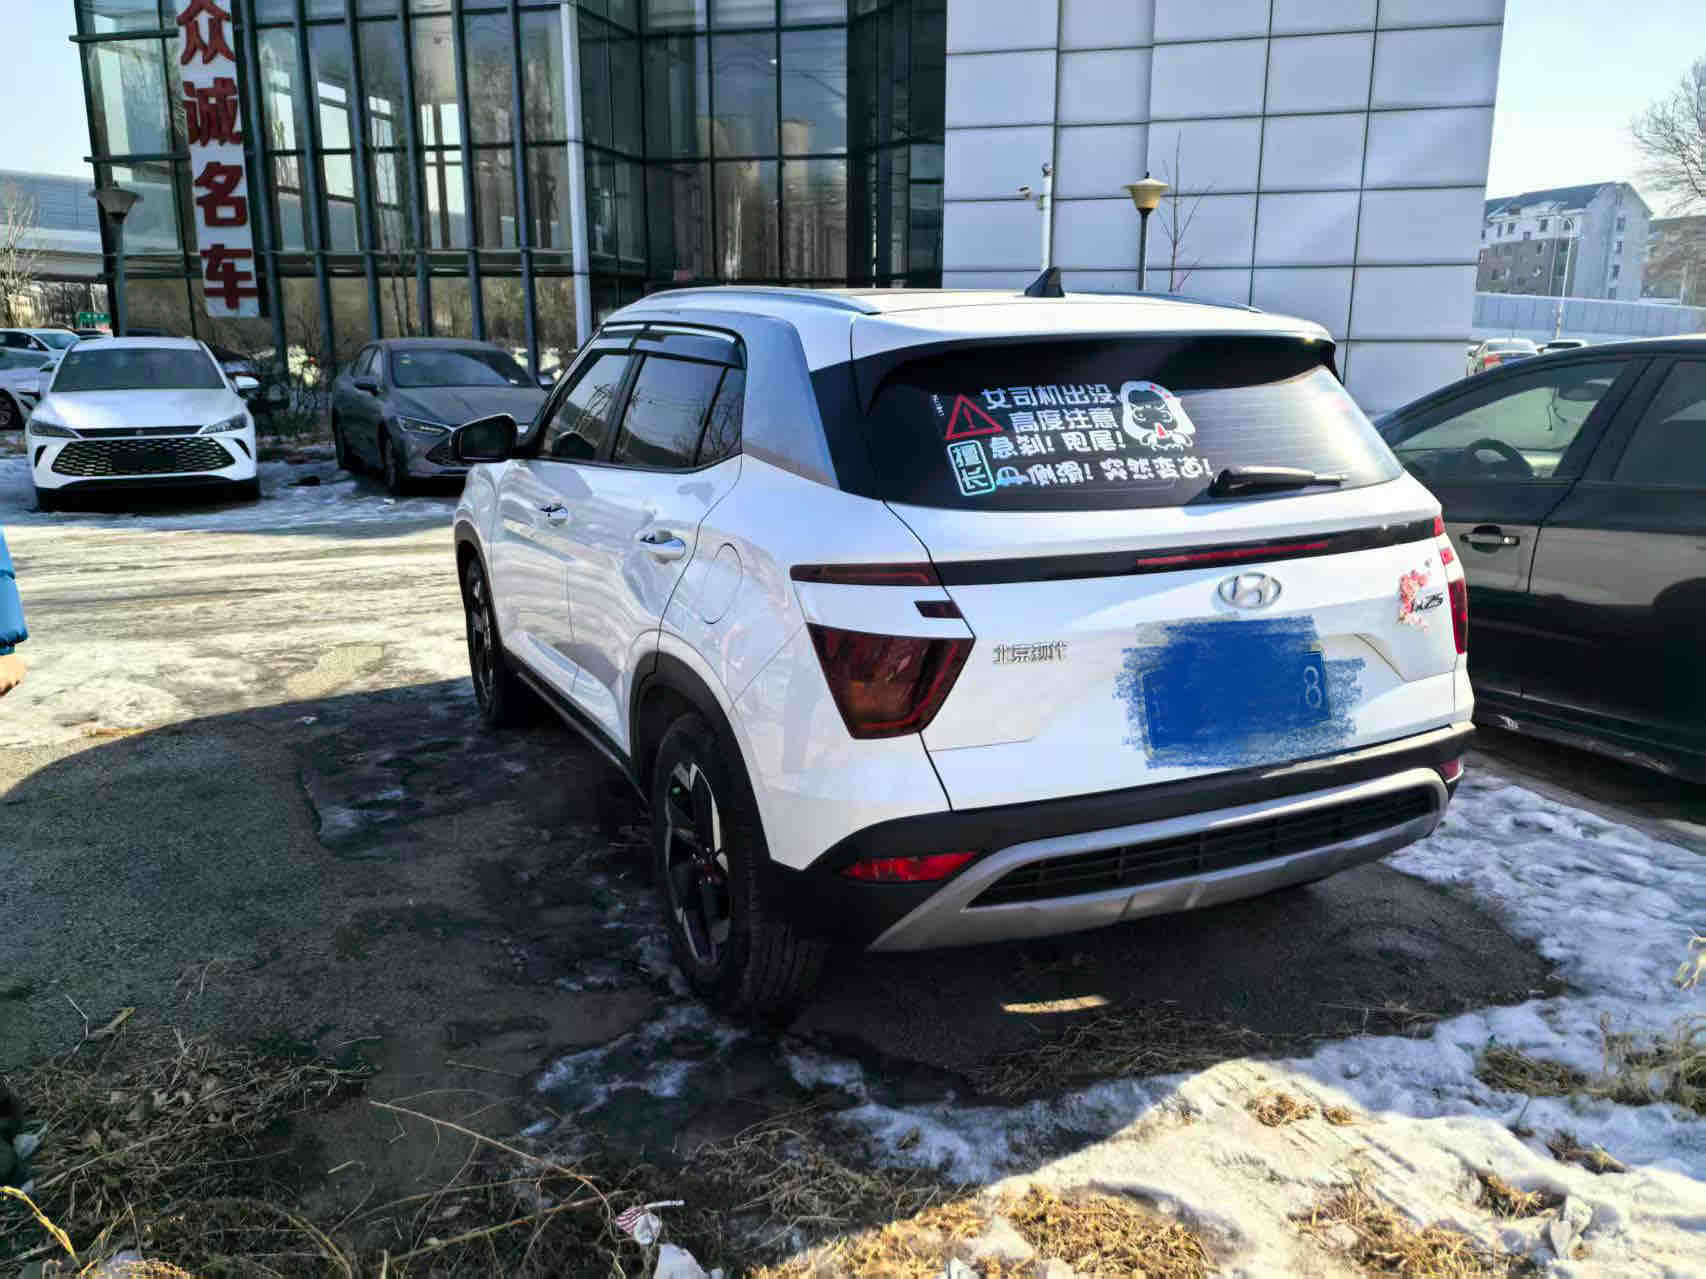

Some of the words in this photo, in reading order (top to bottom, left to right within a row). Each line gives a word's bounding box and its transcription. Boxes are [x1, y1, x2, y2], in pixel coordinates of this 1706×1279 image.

[176, 0, 260, 310] 众诚名车
[981, 383, 1118, 410] 女司机出没
[1008, 407, 1119, 434] 高度注意
[992, 640, 1067, 665] 北京现代
